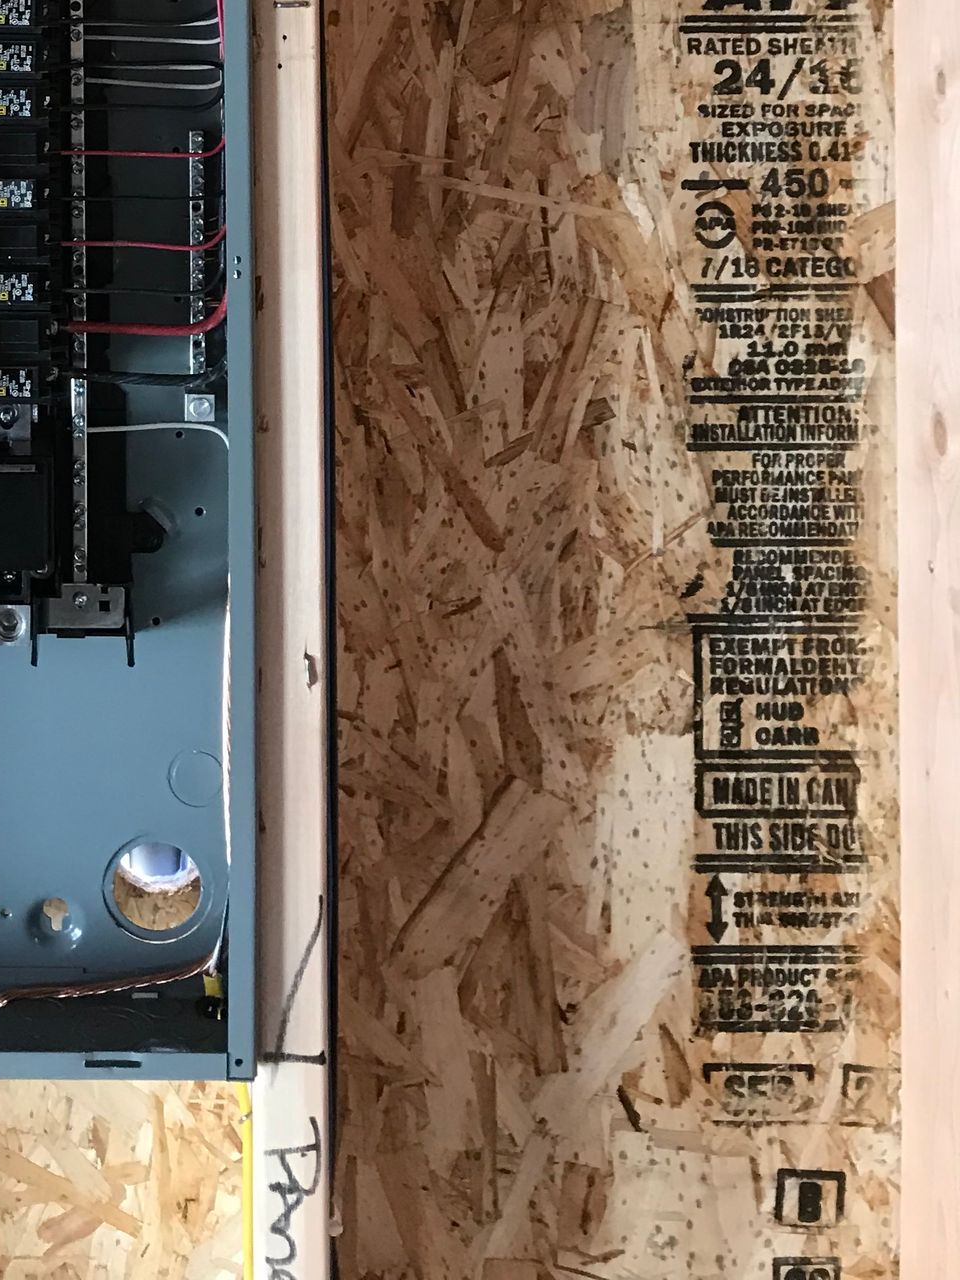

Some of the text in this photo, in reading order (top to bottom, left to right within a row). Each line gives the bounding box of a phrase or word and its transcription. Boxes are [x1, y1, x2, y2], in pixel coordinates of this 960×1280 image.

[687, 37, 762, 56] RATED
[697, 104, 756, 119] SIZED
[761, 103, 800, 118] FOR
[721, 121, 848, 138] EXPOSURE
[689, 141, 804, 163] THICKNESS
[760, 167, 829, 198] 450
[746, 341, 800, 358] 11.0
[773, 377, 816, 391] TYPE
[751, 452, 846, 469] FOR PROPER
[711, 469, 825, 486] PERFORMANCE
[714, 487, 756, 504] MUST
[726, 504, 830, 521] ACCORDANCE
[709, 637, 798, 656] EXEMPT
[755, 701, 805, 722] HUD
[712, 776, 772, 806] MADE
[777, 776, 800, 806] IN
[712, 822, 763, 851] THIS
[768, 822, 819, 852] SIDE
